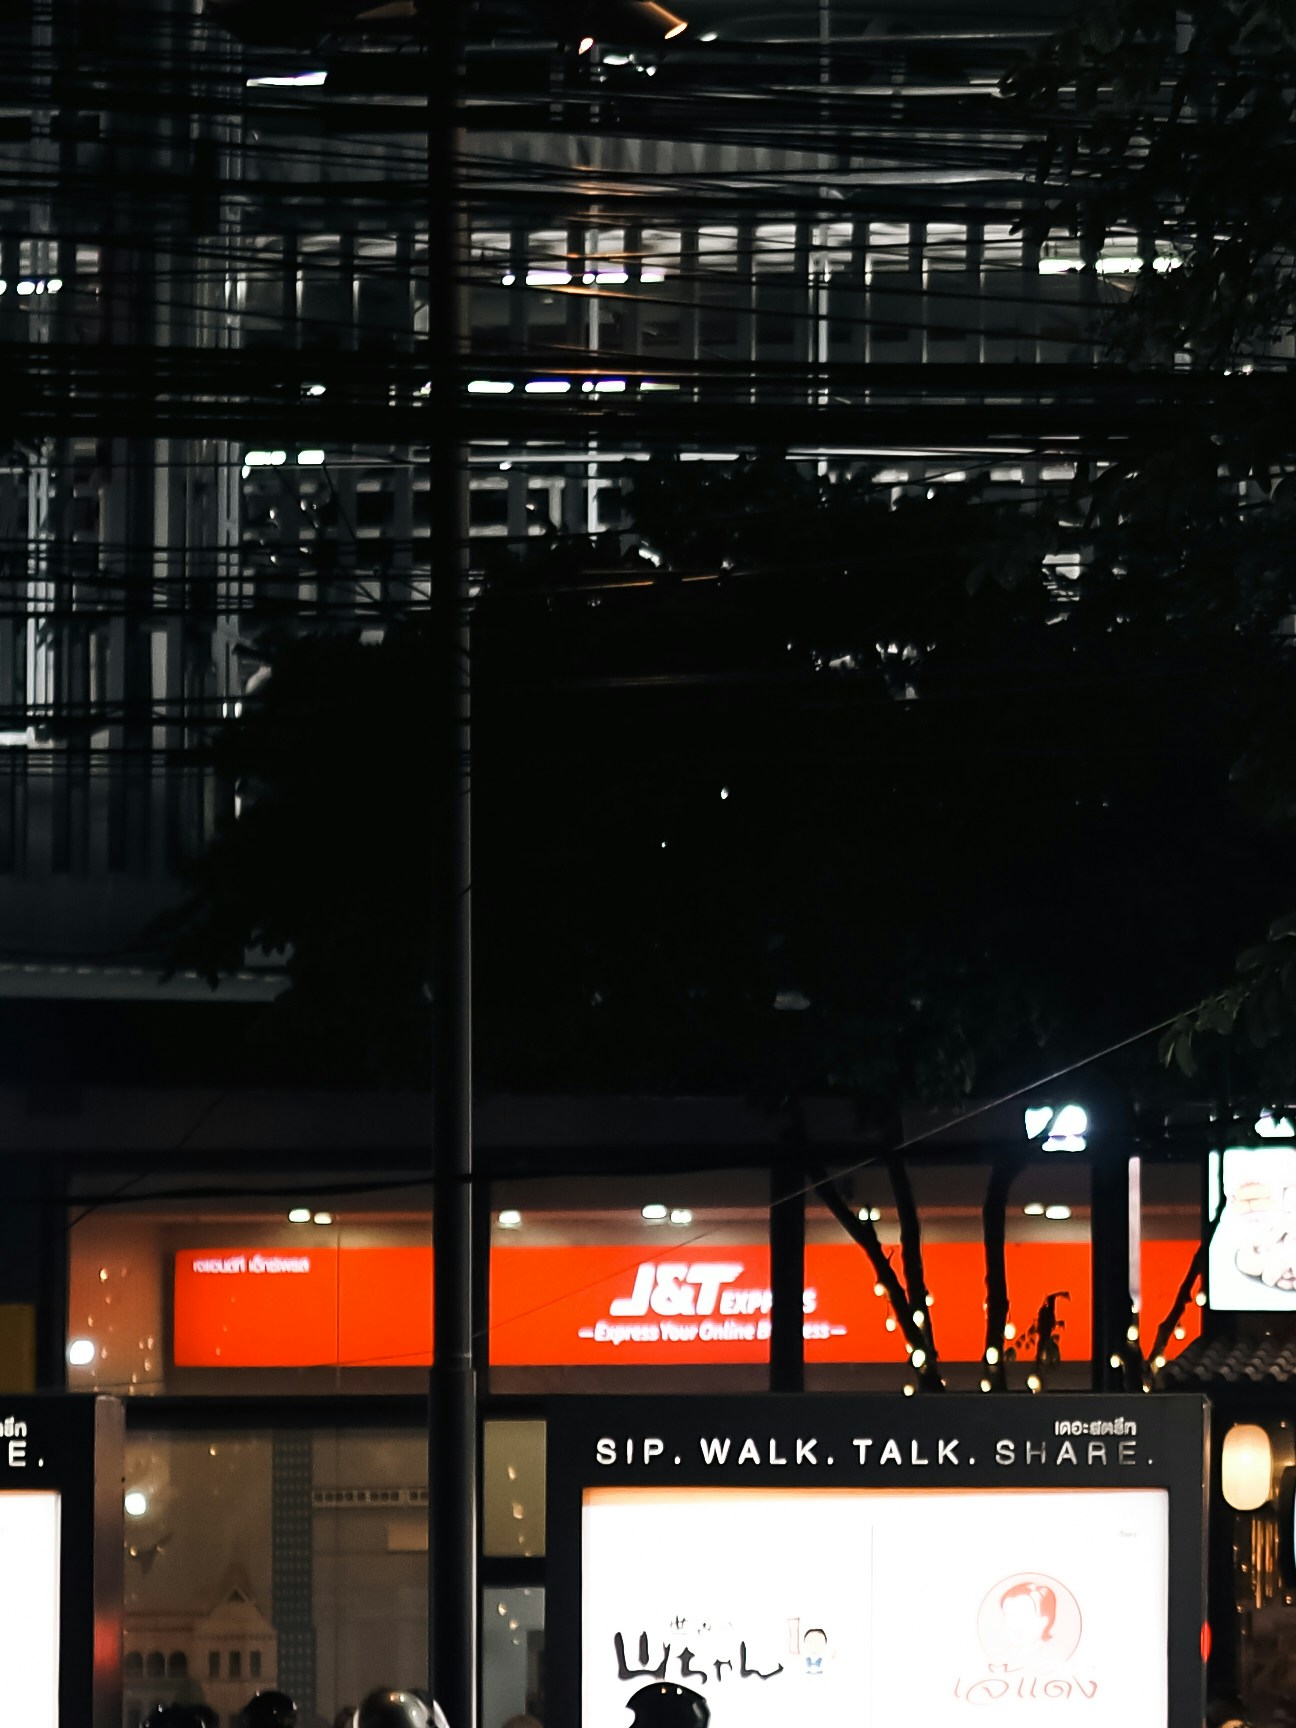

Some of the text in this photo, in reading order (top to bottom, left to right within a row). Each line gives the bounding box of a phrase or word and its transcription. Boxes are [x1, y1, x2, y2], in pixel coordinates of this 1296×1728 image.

[609, 1262, 817, 1316] J&T EXPRS
[593, 1321, 660, 1345] Express
[660, 1321, 698, 1342] Your
[699, 1320, 755, 1341] Online
[596, 1438, 1154, 1465] SIP. WALK. TALK. SHARE.
